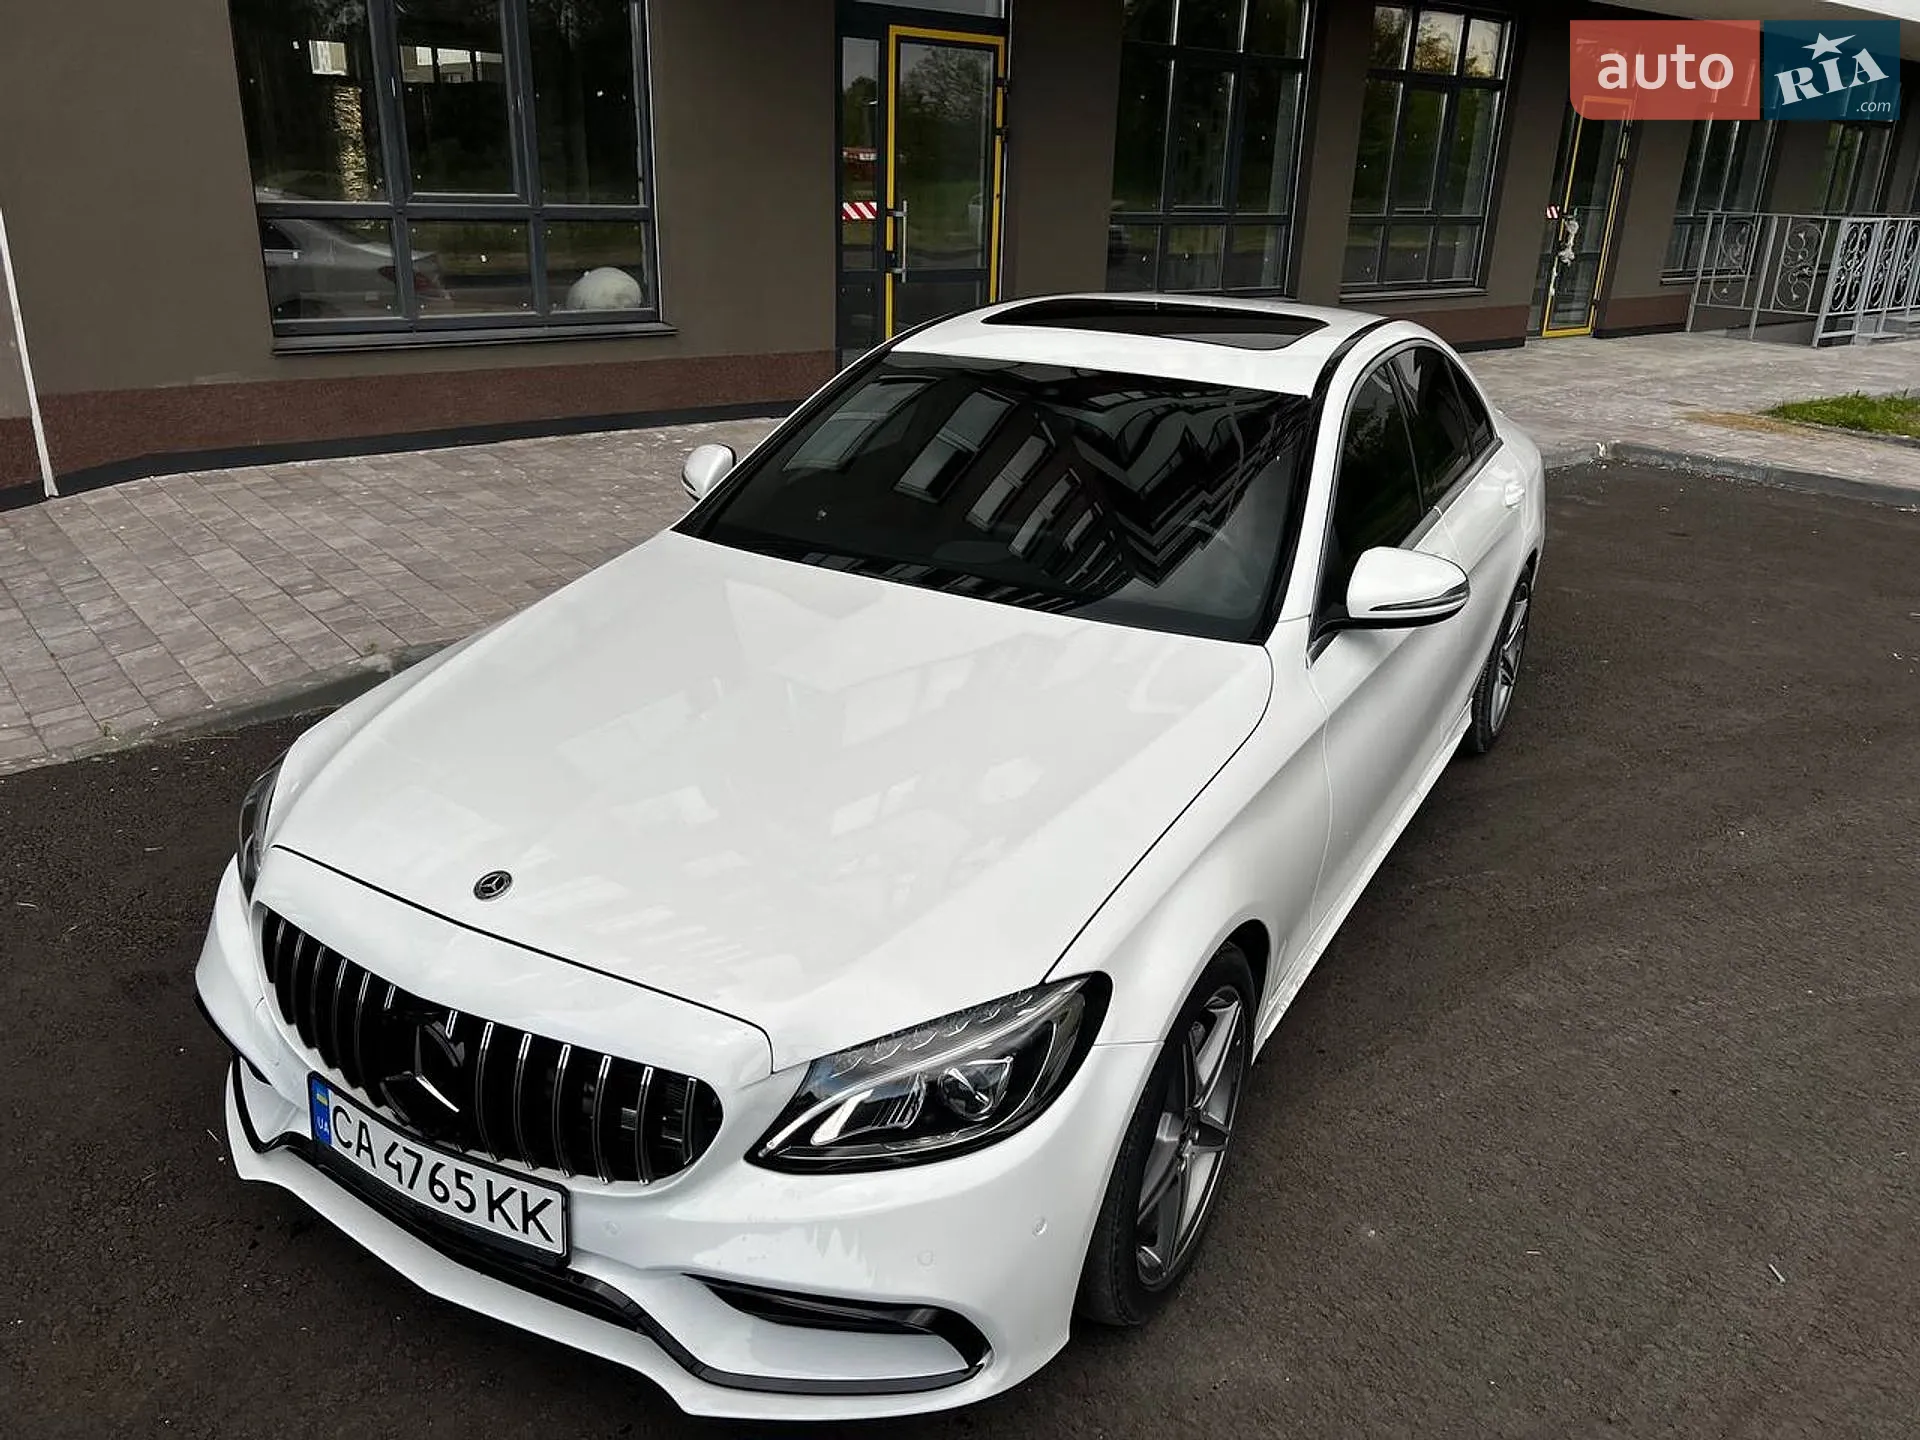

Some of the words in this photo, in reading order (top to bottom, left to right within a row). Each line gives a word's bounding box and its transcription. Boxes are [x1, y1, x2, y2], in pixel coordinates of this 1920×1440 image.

[317, 1116, 330, 1137] UA
[332, 1105, 376, 1169] CA
[384, 1141, 477, 1213] 4765
[486, 1179, 554, 1243] KK
